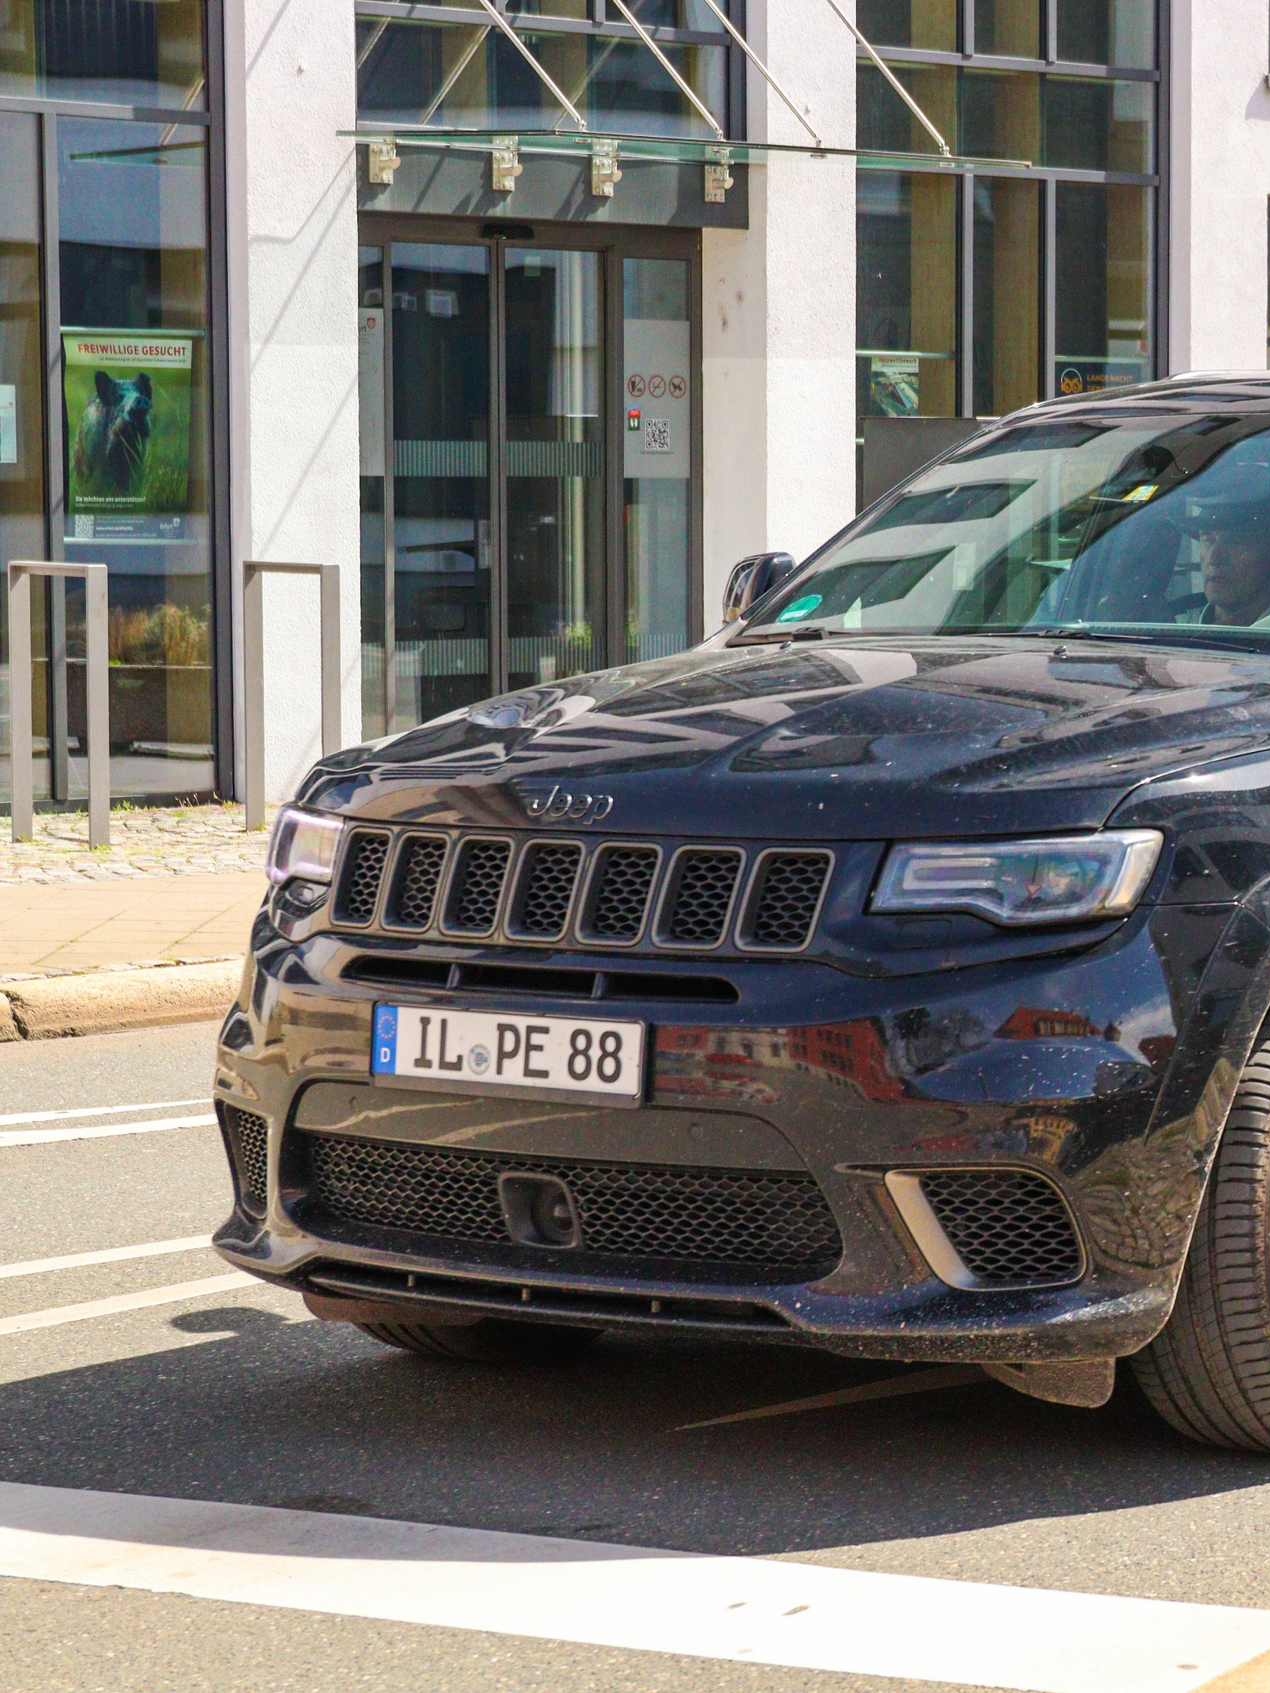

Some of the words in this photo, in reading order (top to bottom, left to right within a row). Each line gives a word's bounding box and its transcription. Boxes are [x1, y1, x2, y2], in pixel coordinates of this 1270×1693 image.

[77, 343, 140, 356] FREIWILLIGE
[141, 345, 187, 357] GESUCHT
[527, 785, 614, 825] Jeep
[380, 1047, 390, 1063] D
[413, 1016, 463, 1071] IL
[496, 1023, 550, 1079] PE
[567, 1028, 622, 1083] 88
